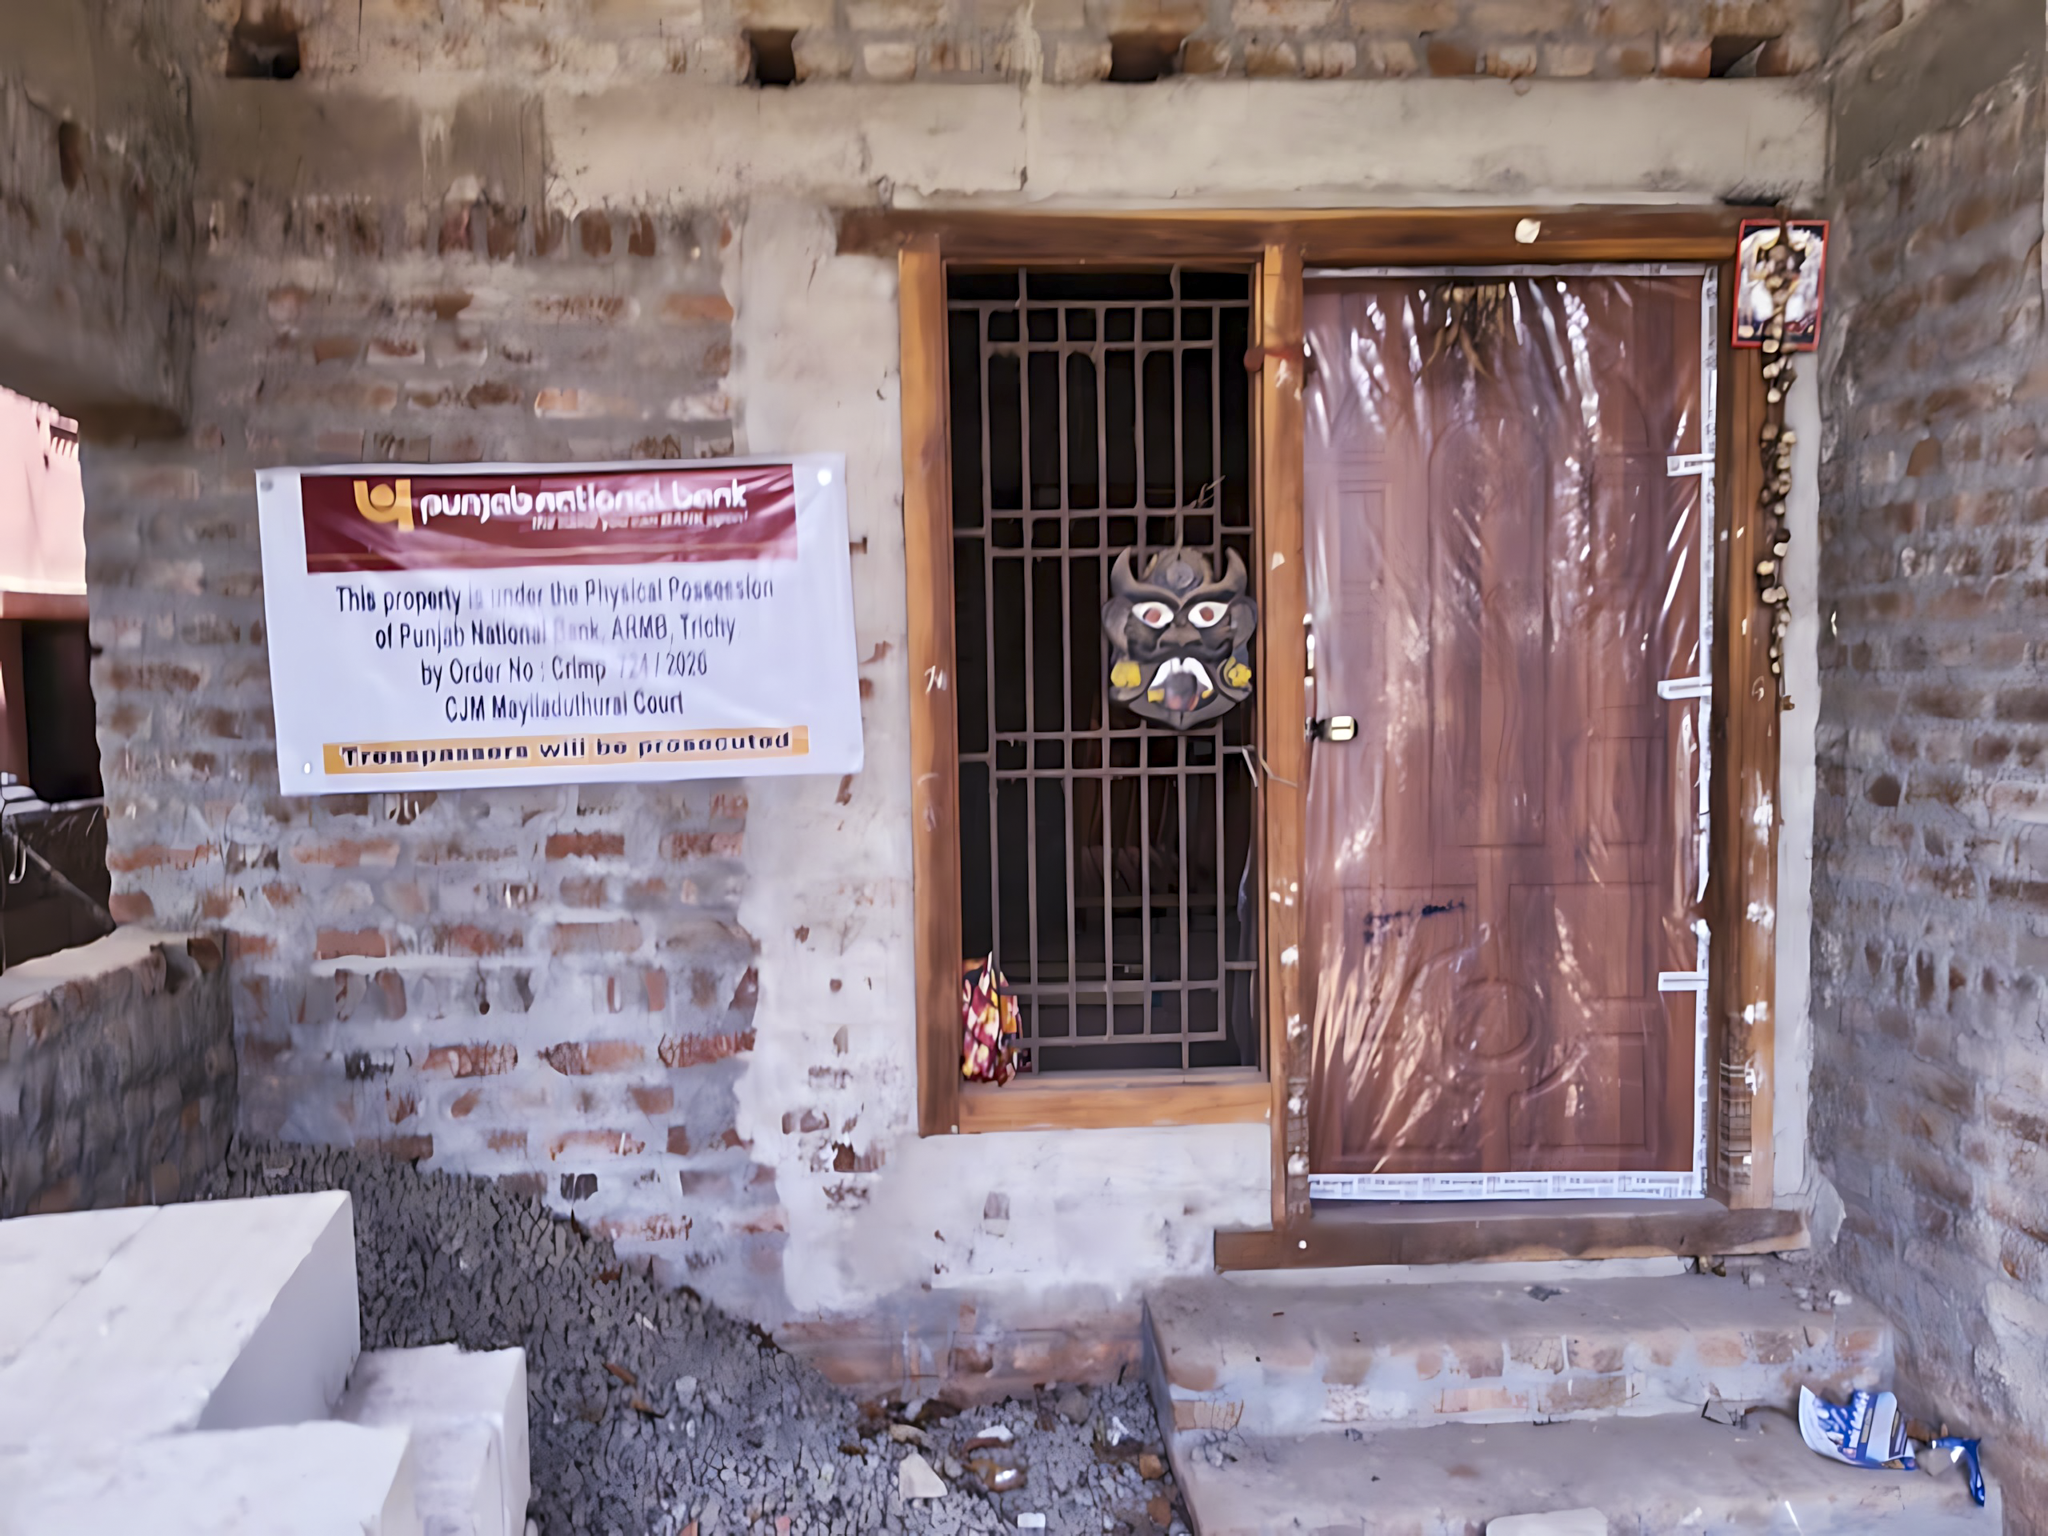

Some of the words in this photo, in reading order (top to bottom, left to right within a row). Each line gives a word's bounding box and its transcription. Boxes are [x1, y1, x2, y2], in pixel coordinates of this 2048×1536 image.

[420, 485, 532, 525] punjab
[535, 478, 665, 513] national
[672, 478, 747, 510] bank
[336, 584, 376, 612] This
[375, 622, 392, 649] of
[400, 619, 464, 654] Punjab
[421, 658, 442, 693] by
[450, 656, 501, 684] Order
[445, 695, 485, 723] CJM
[633, 687, 683, 715] Court
[540, 738, 585, 758] will
